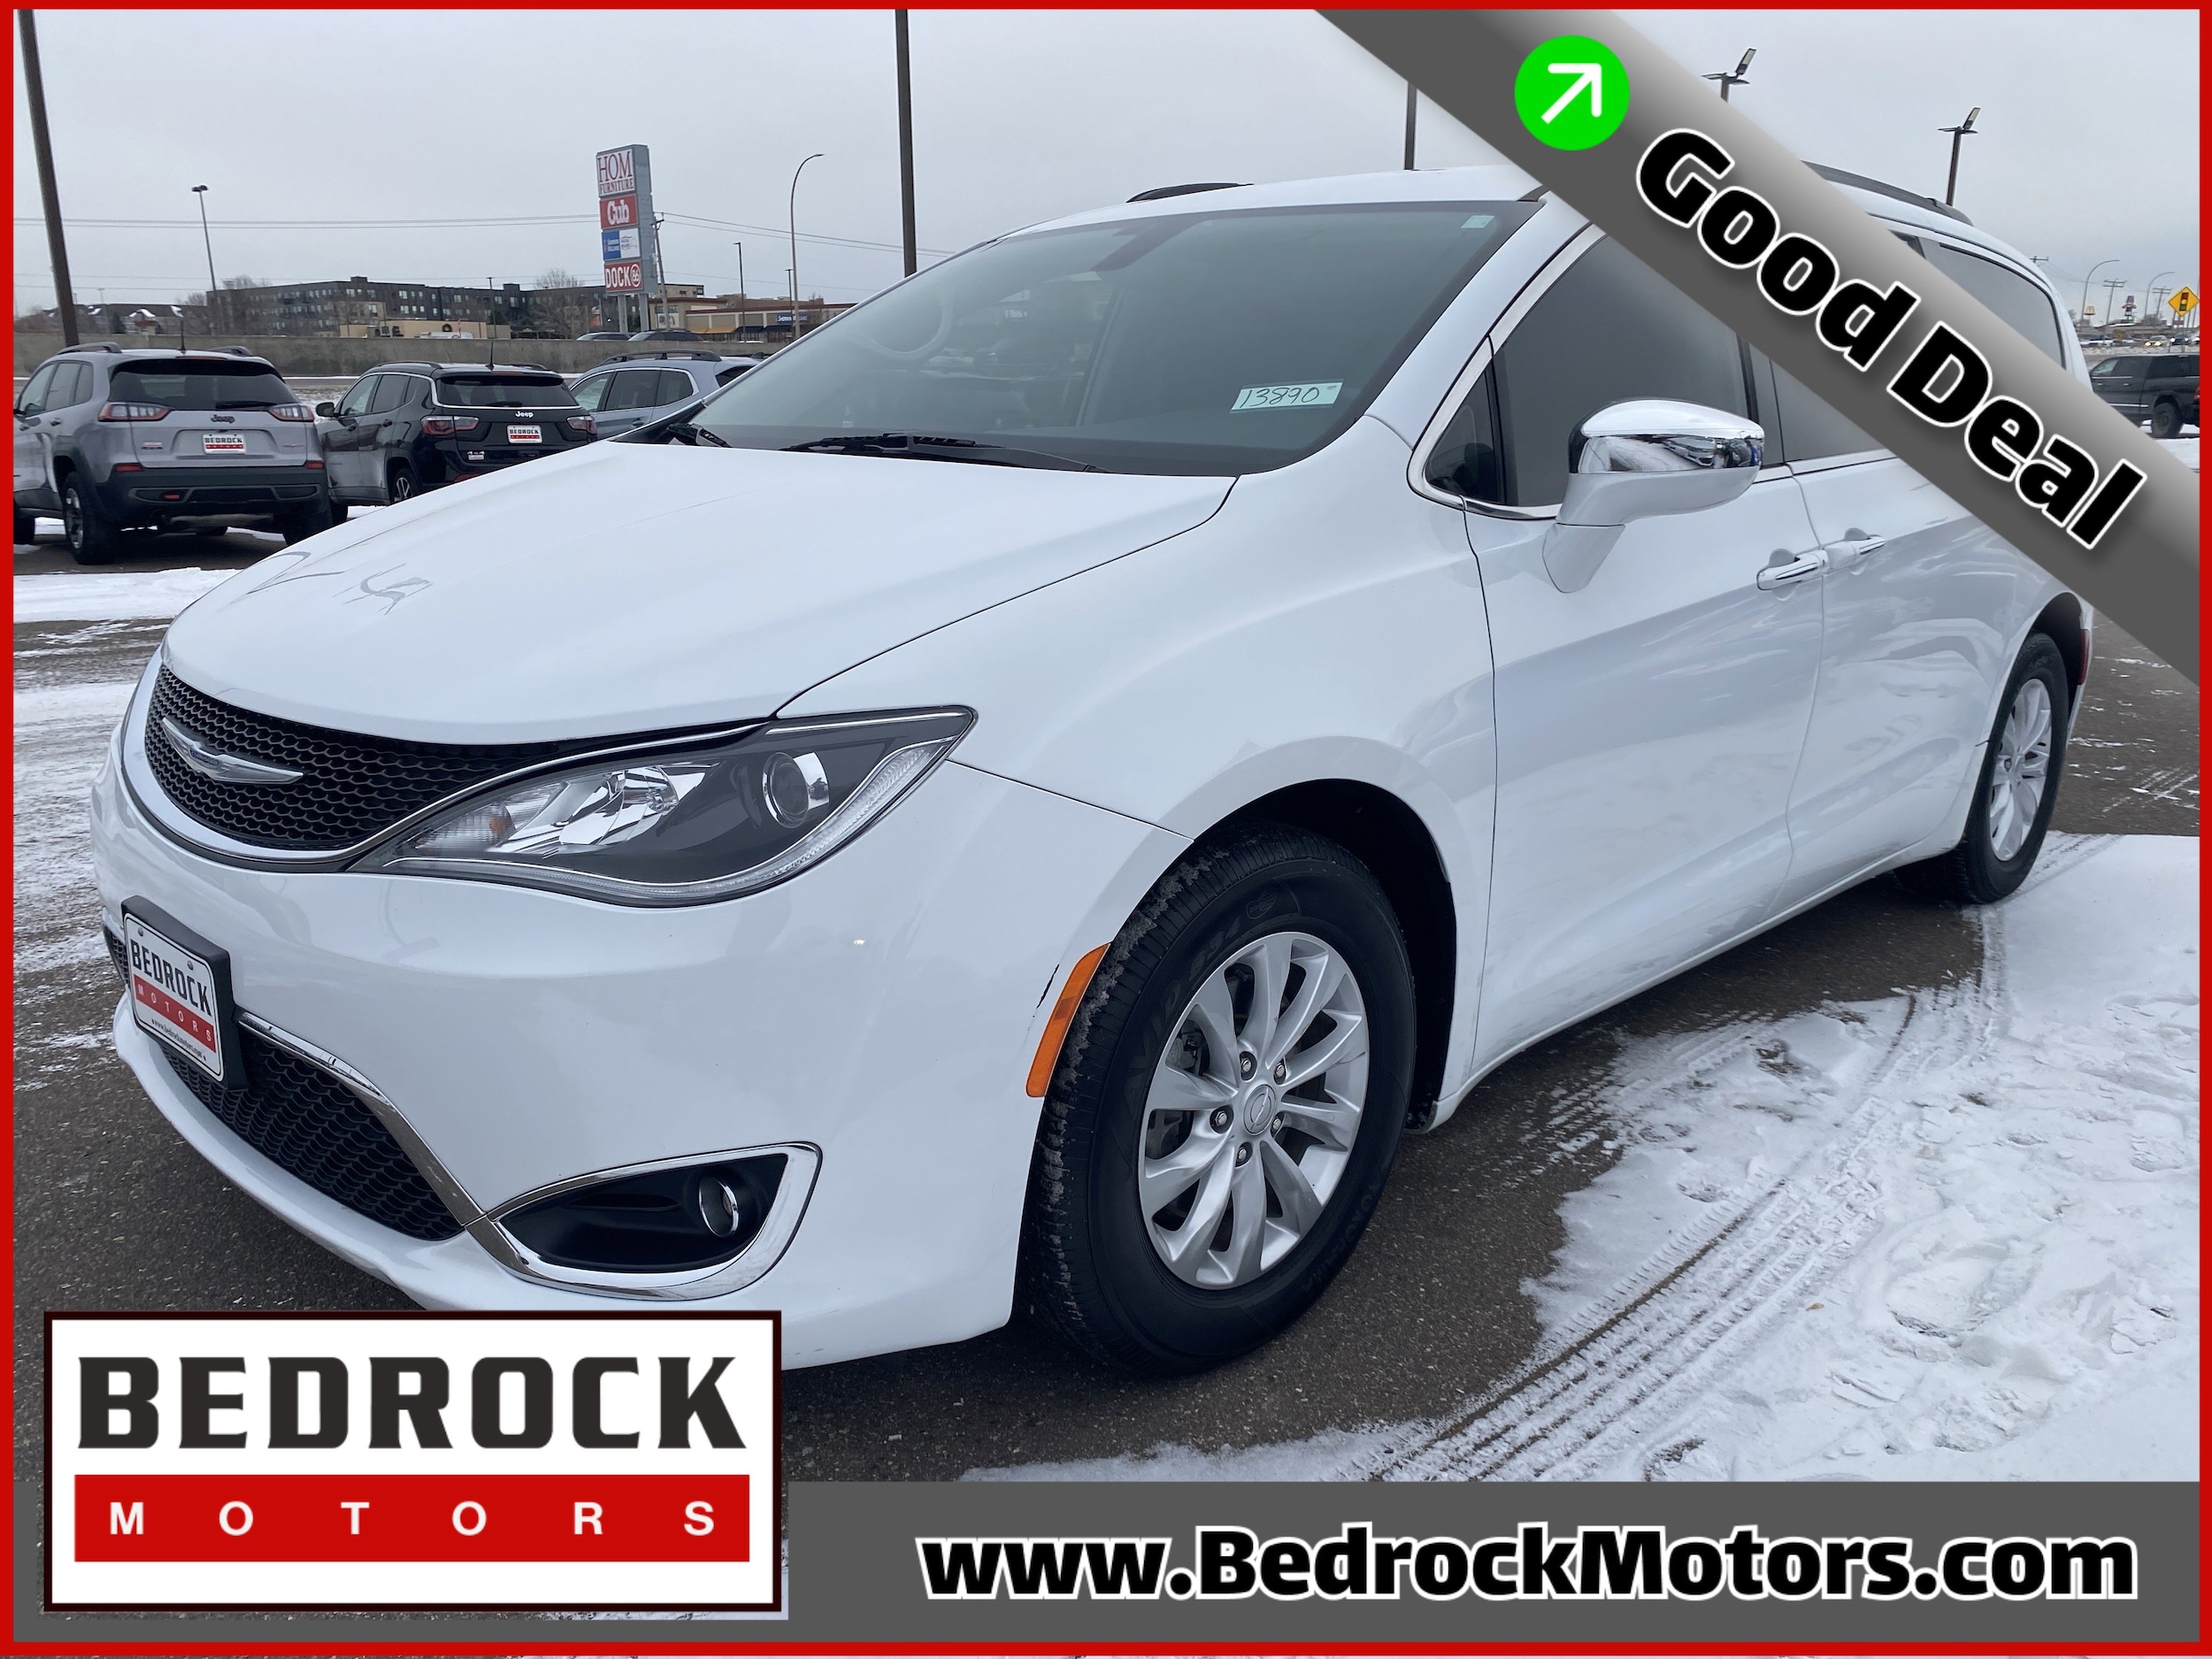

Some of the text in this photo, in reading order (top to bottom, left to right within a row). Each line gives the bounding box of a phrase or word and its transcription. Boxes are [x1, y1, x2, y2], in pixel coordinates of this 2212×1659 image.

[597, 151, 633, 182] HOM
[599, 178, 634, 195] FURNITURE
[607, 199, 629, 226] Cub
[605, 266, 632, 288] DOCK
[1240, 387, 1319, 408] 13890
[210, 414, 235, 424] Jeep
[130, 939, 212, 1018] BEDROCK
[138, 983, 212, 1042] MOTORS
